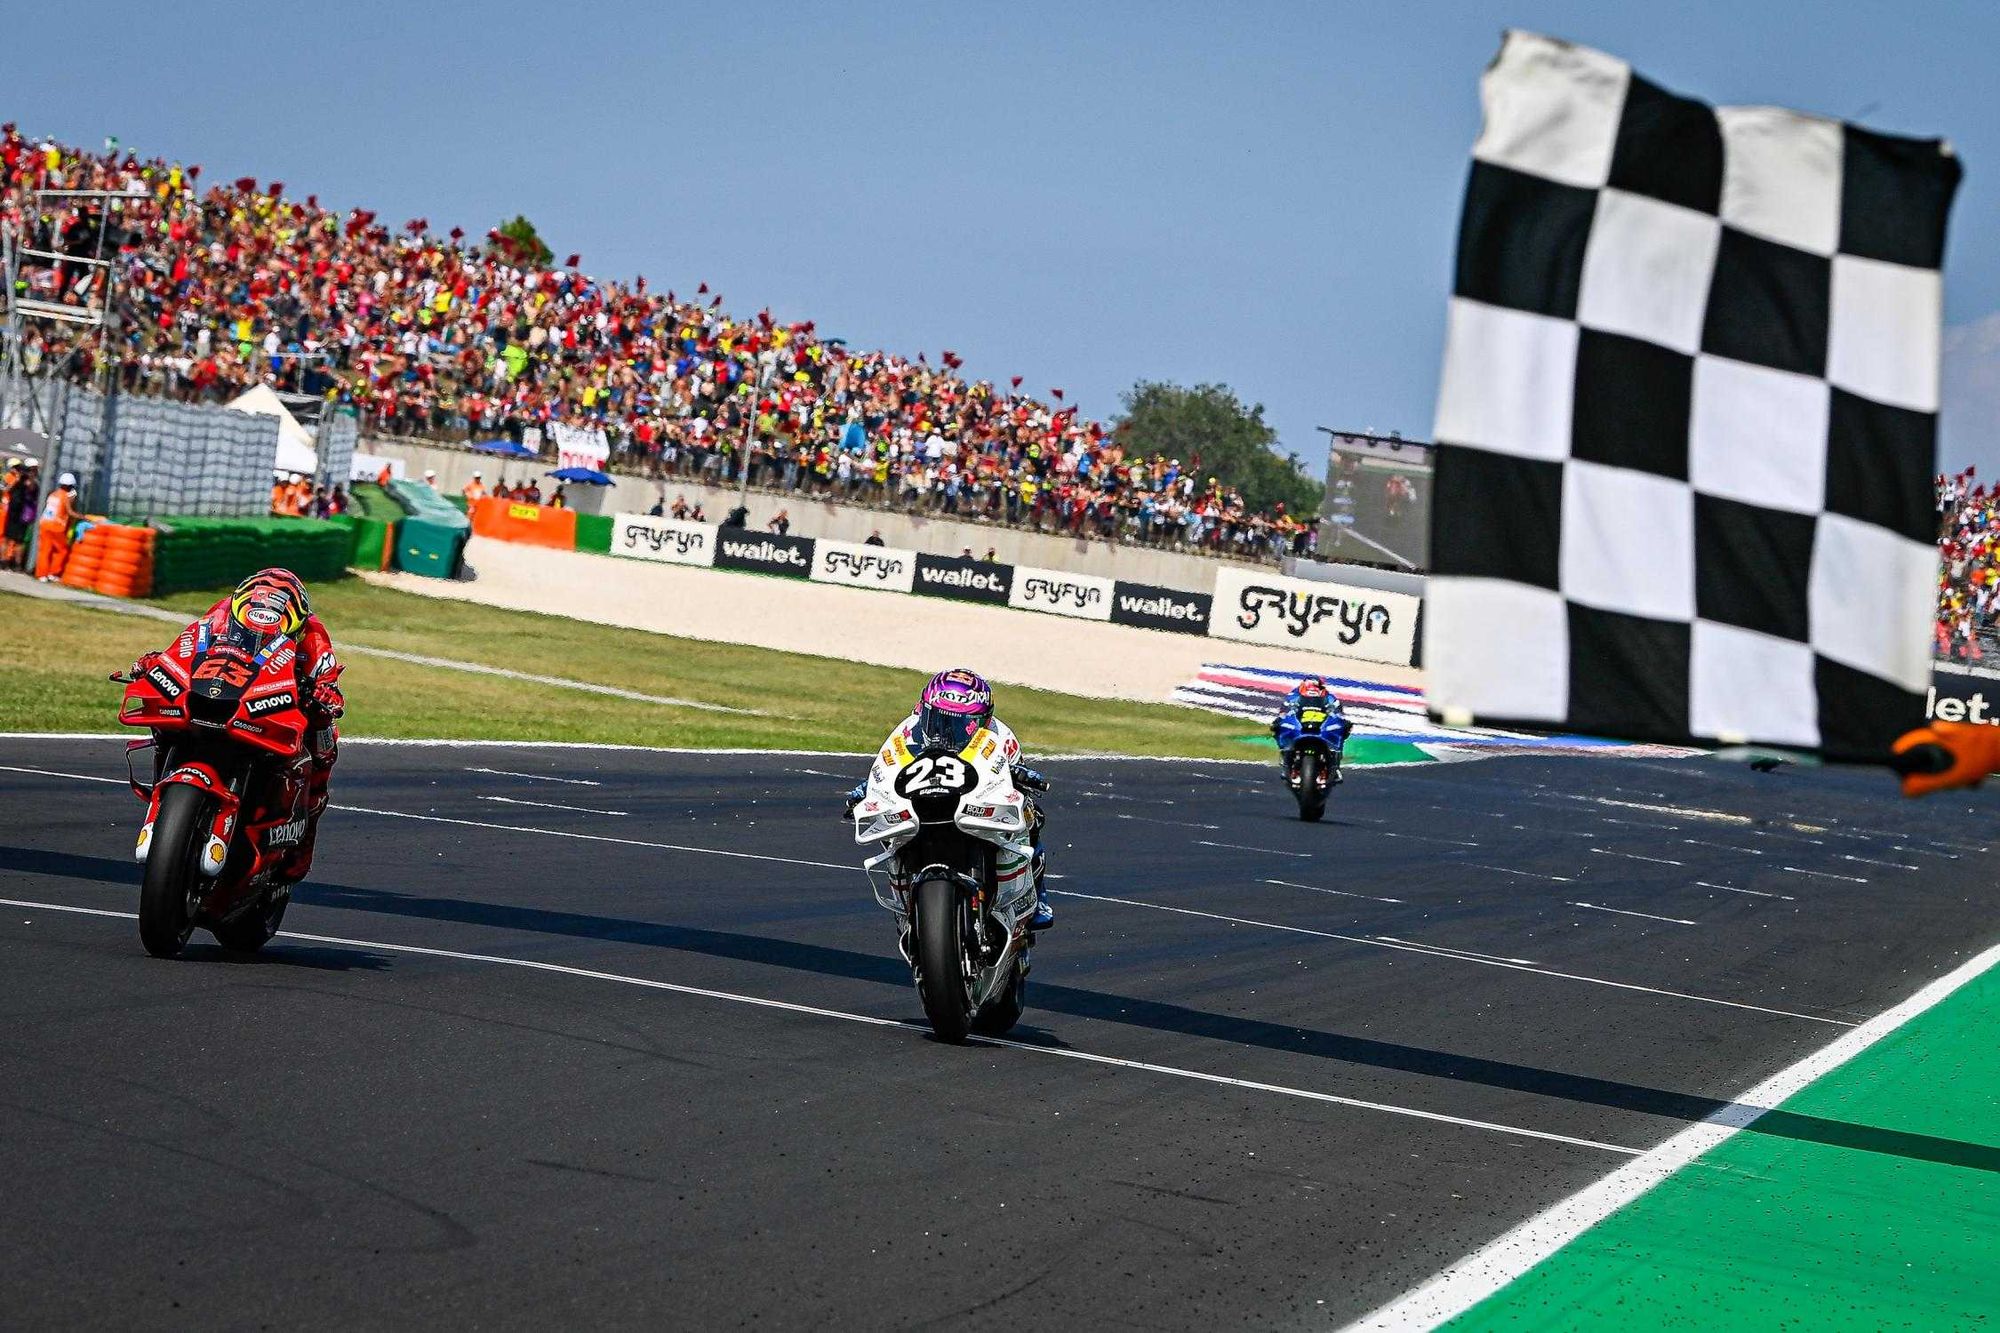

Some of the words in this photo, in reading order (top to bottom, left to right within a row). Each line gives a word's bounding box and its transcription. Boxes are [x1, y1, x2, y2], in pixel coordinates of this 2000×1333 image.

[722, 541, 807, 566] wallet.
[921, 567, 1005, 592] wallet.
[1120, 594, 1204, 622] wallet.
[149, 666, 180, 697] Lenovo
[191, 658, 254, 688] 63
[245, 694, 293, 713] Lenovo
[1925, 685, 2000, 727] let.
[905, 755, 965, 794] 23
[268, 819, 306, 846] Lenovo
